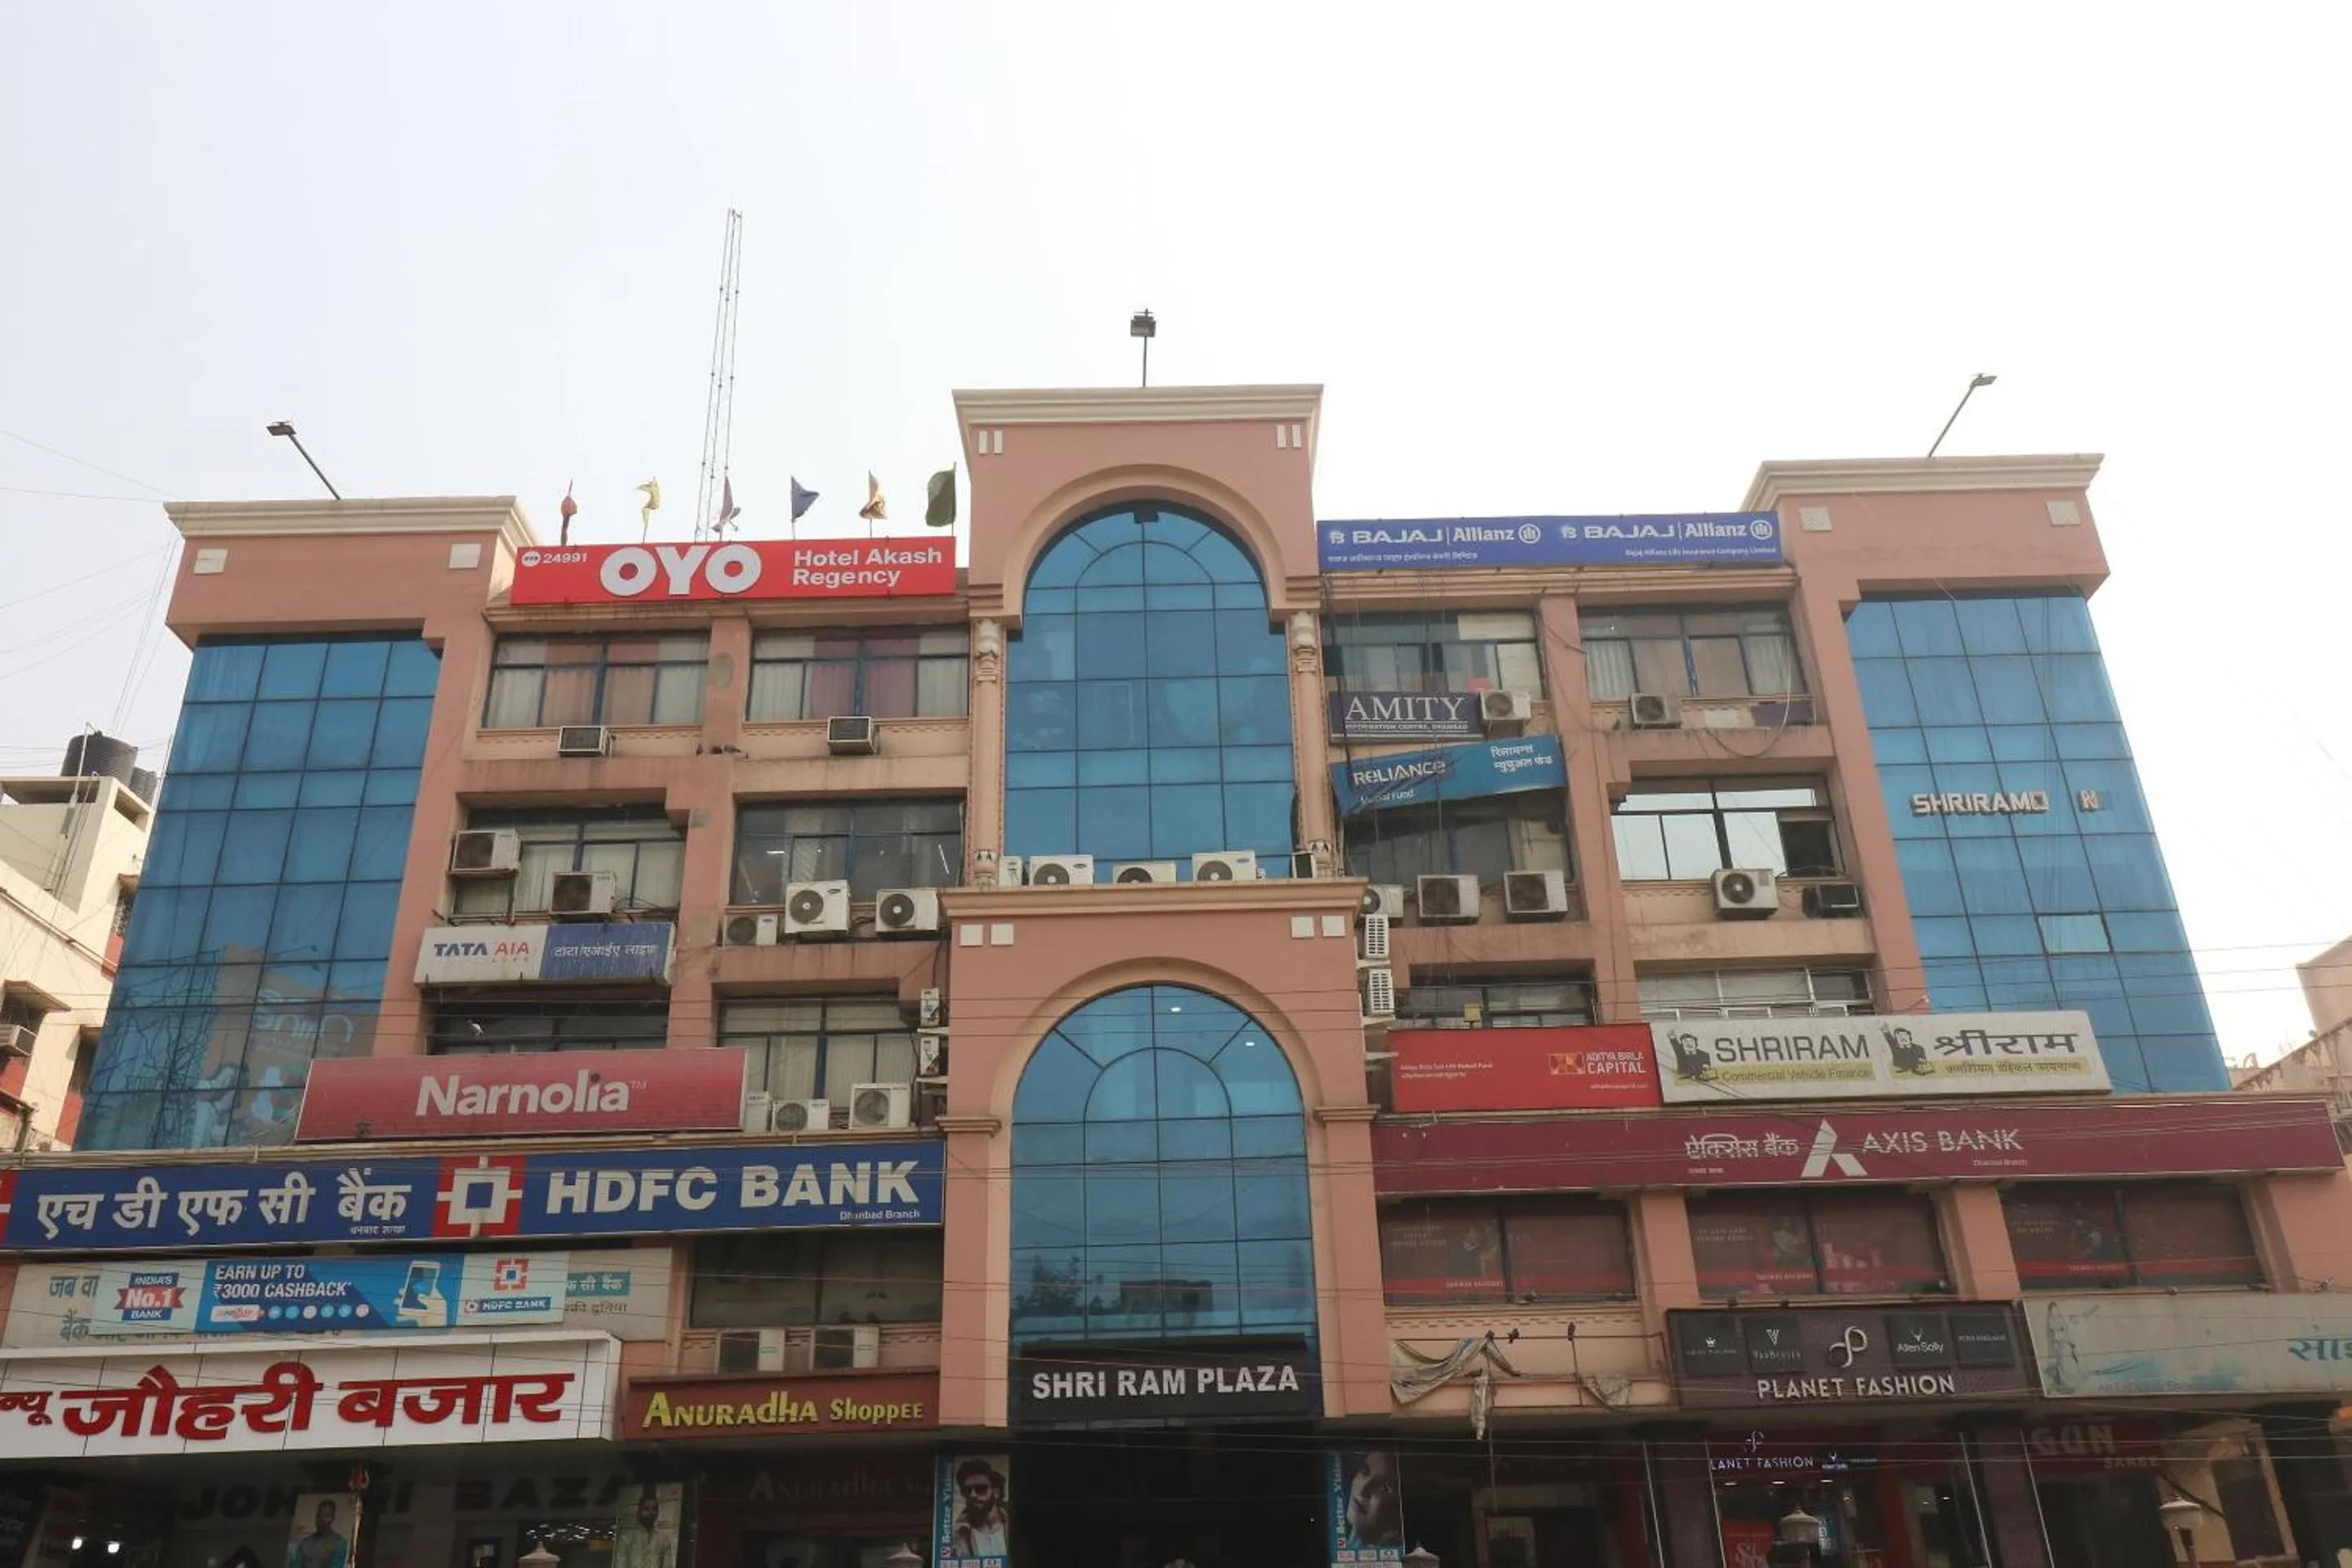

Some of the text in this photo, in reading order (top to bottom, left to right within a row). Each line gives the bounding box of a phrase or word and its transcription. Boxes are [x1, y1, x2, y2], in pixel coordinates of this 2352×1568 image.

[1352, 530, 1443, 545] BAJAJ
[1454, 526, 1514, 541] Allianz
[1585, 525, 1673, 539] BAJAJ
[1685, 523, 1746, 537] Allianz
[795, 547, 942, 566] Hotel Akash
[600, 544, 762, 596] OYO
[793, 568, 901, 587] Regency
[1345, 697, 1468, 720] AMITY
[434, 942, 529, 956] TATA AIA
[1715, 1034, 1871, 1062] SHRIRAM
[1933, 1028, 2078, 1057] श्रीराम
[1588, 1061, 1647, 1076] CAPITAL
[1722, 1067, 1786, 1081] Commercial
[416, 1069, 630, 1116] Narnolia
[1762, 1133, 1799, 1156] बैंक
[1862, 1129, 2024, 1156] AXIS BANK
[546, 1160, 920, 1214] HDFC BANK
[37, 1167, 412, 1240] एच डी एफ सी बैंक
[885, 1209, 920, 1220] Branch
[216, 1264, 305, 1281] EARN UP TO
[125, 1287, 173, 1307] No.1
[214, 1283, 260, 1299] ₹3000
[483, 1300, 547, 1310] HDFC BANK
[131, 1310, 163, 1320] BANK
[1897, 1341, 1944, 1354] Allen Solly
[1033, 1365, 1299, 1400] SHRI RAM PLAZA
[1757, 1374, 1956, 1400] PLANET FASHION
[59, 1362, 323, 1441] जौहरी
[338, 1373, 574, 1428] बजार
[1708, 1457, 1750, 1471] LANET
[1757, 1456, 1814, 1468] FASHION
